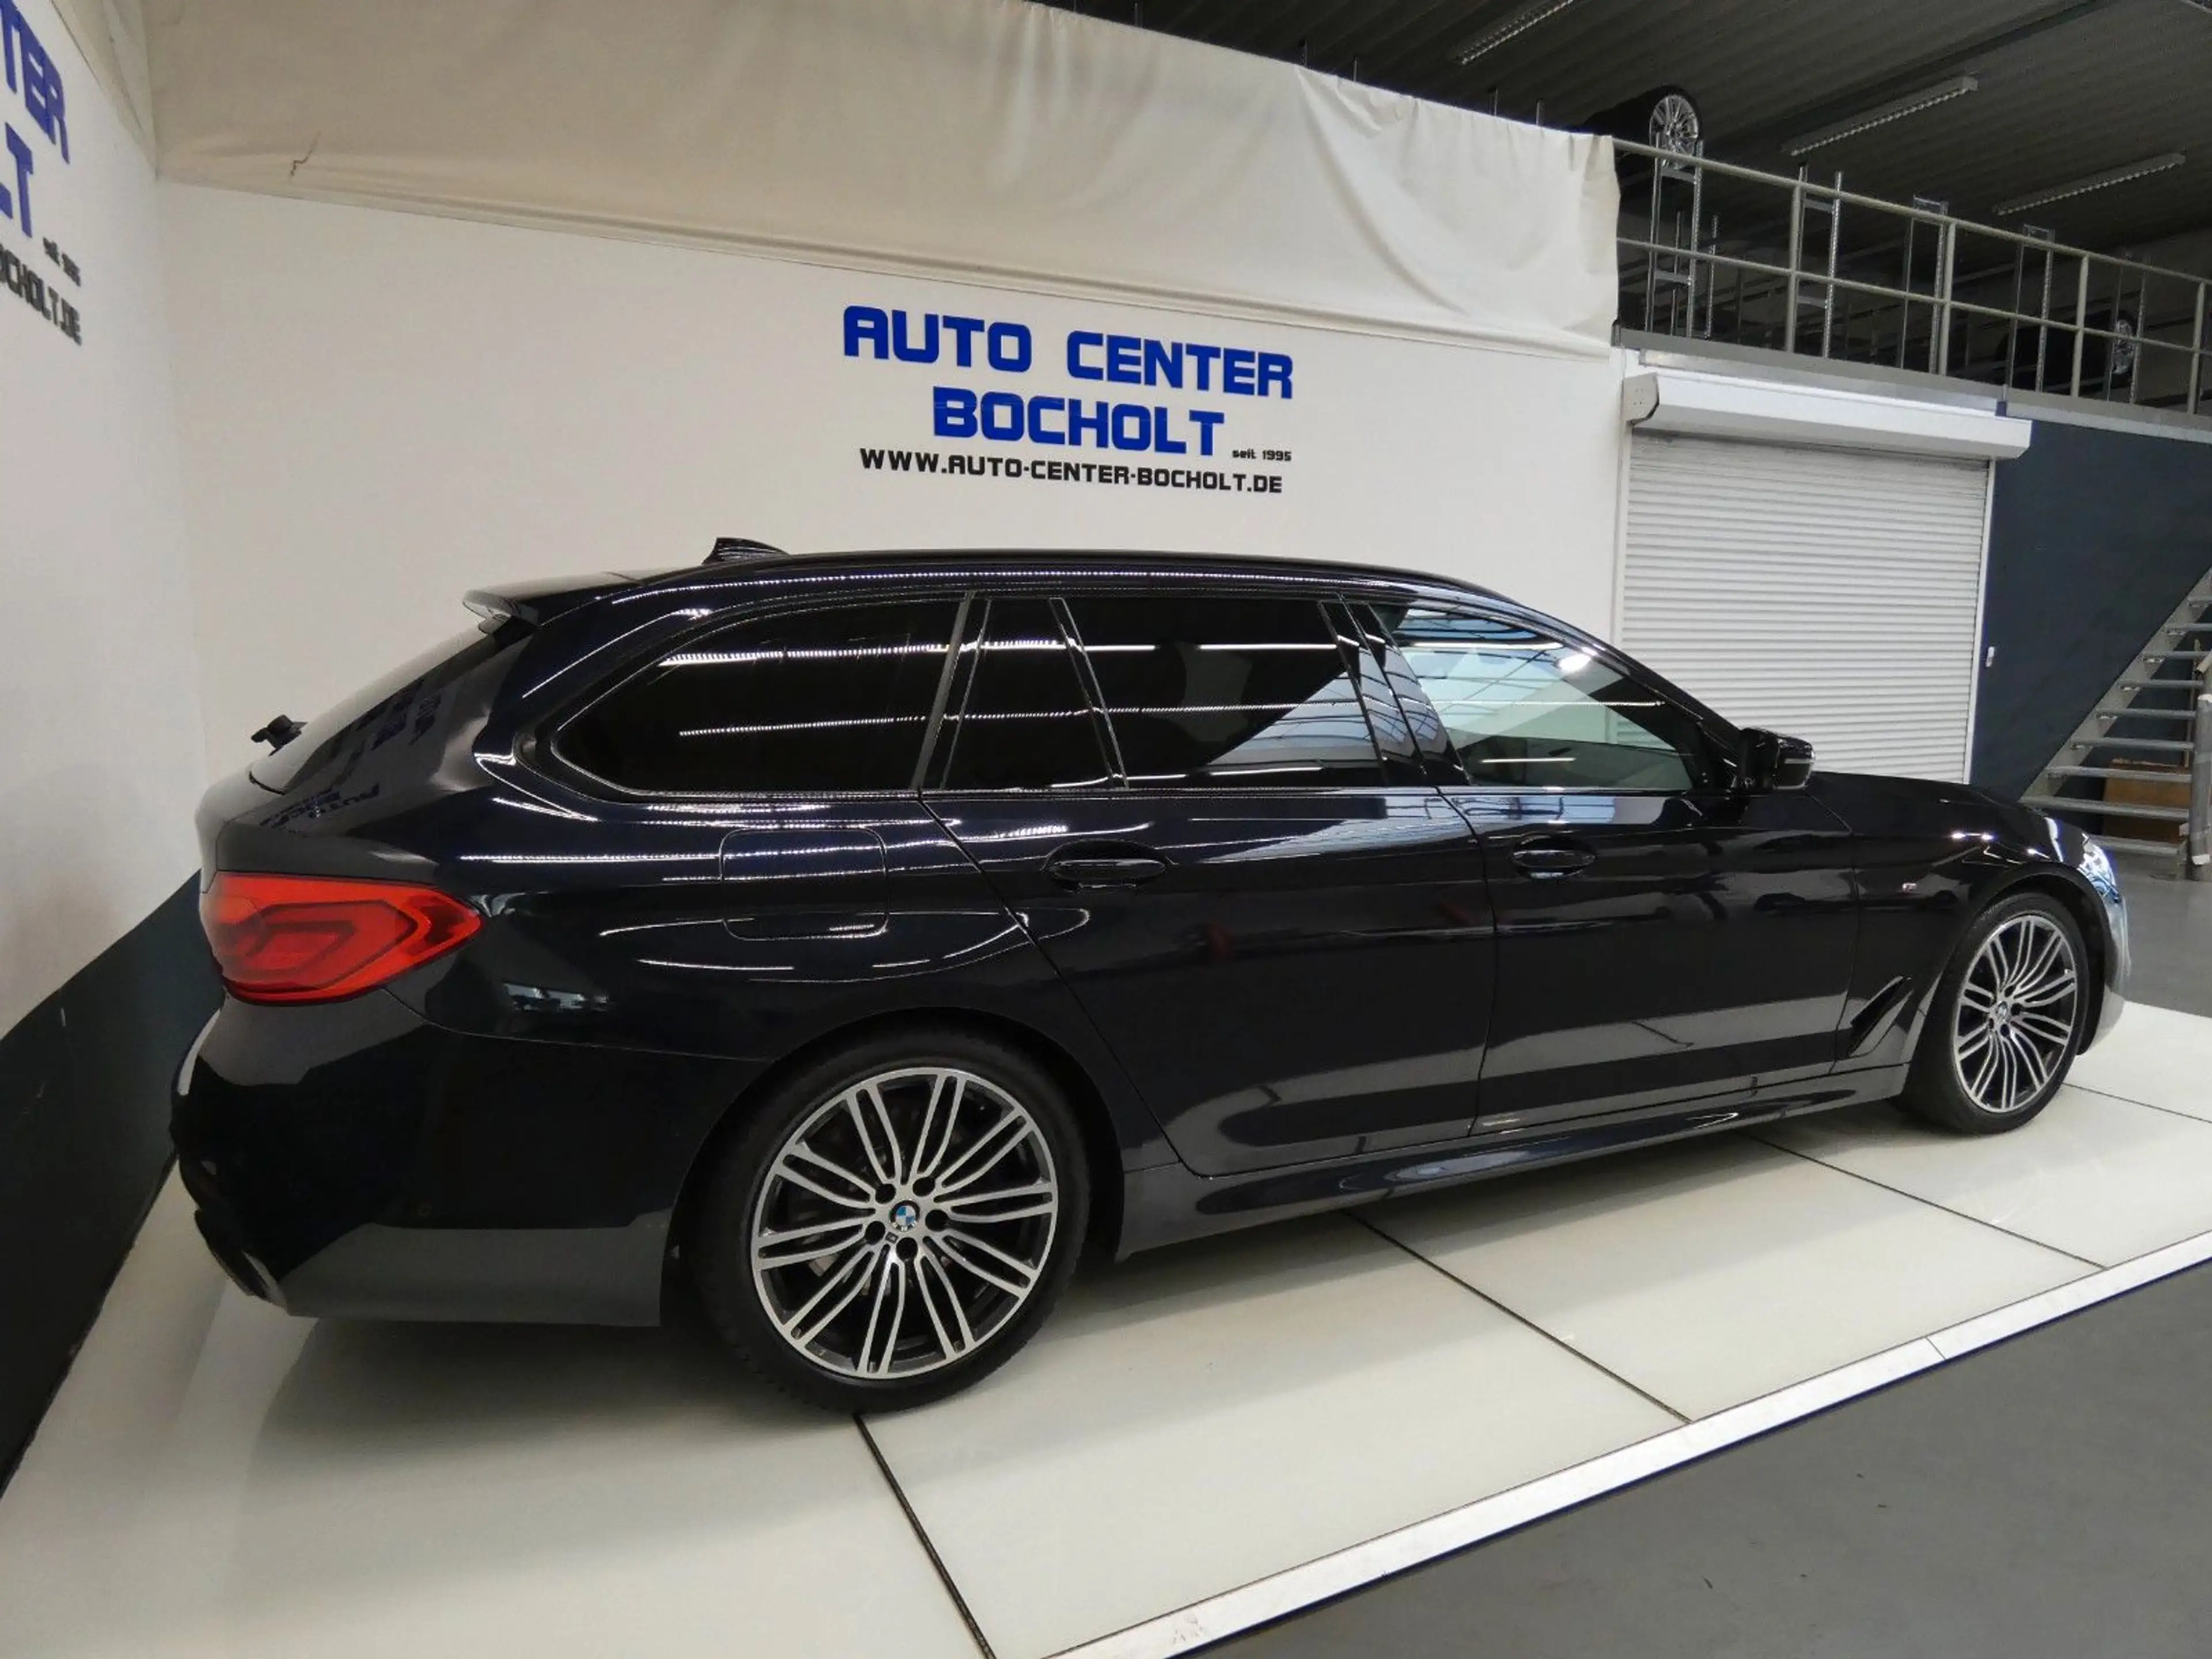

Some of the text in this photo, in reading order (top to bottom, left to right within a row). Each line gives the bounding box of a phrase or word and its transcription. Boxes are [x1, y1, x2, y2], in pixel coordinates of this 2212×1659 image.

[843, 305, 1293, 399] AUTO CENTER
[933, 386, 1225, 457] BOCHOLT
[860, 448, 1282, 493] WWW.AUTO-CENTER-BOCHOLT.DE
[1232, 449, 1291, 461] seit 1995
